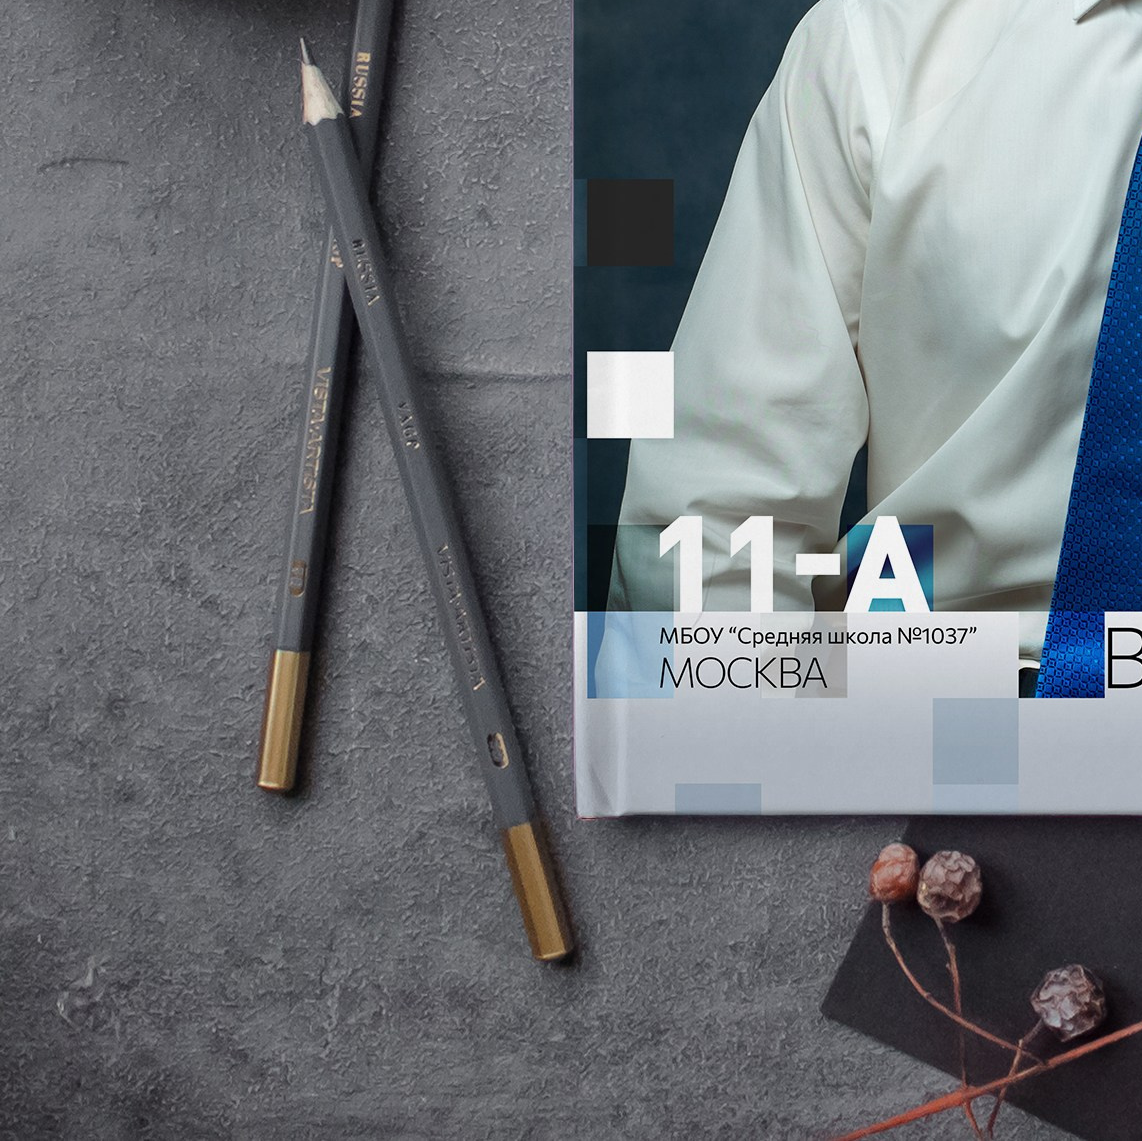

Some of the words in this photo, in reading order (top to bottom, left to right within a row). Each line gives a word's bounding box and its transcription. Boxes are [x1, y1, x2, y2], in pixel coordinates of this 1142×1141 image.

[349, 51, 371, 119] RUSSIA
[352, 238, 380, 307] RUSSIA
[659, 515, 931, 613] 11-А
[659, 626, 724, 645] МБОУ
[729, 626, 821, 647] “Средняя
[828, 632, 892, 645] школа
[659, 656, 828, 689] МОСКВА
